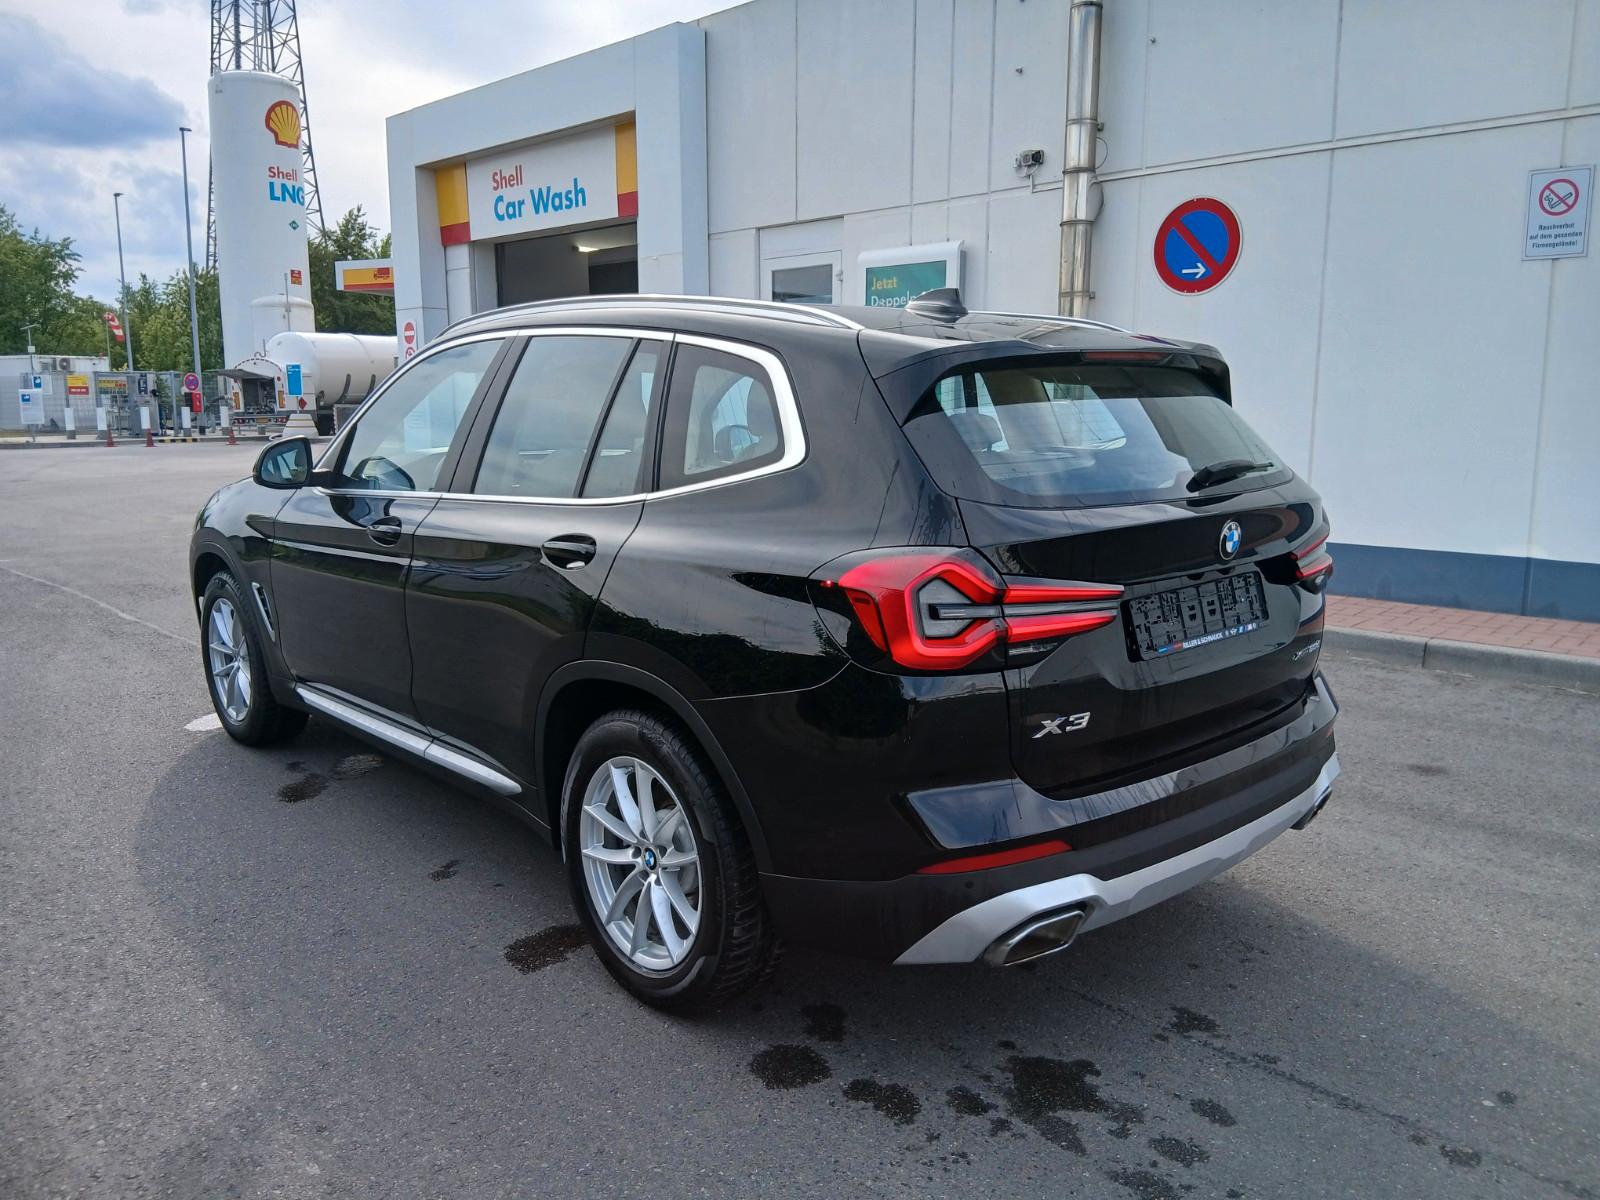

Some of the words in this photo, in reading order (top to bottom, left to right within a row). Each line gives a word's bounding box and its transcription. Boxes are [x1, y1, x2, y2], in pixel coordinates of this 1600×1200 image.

[268, 165, 298, 181] Shell
[492, 164, 523, 192] Shell
[269, 181, 305, 206] LNG
[494, 194, 525, 221] Car
[529, 177, 587, 215] Wash
[1538, 223, 1575, 231] Rauchverbot
[871, 276, 897, 290] Jetzt
[1032, 711, 1091, 738] X3
